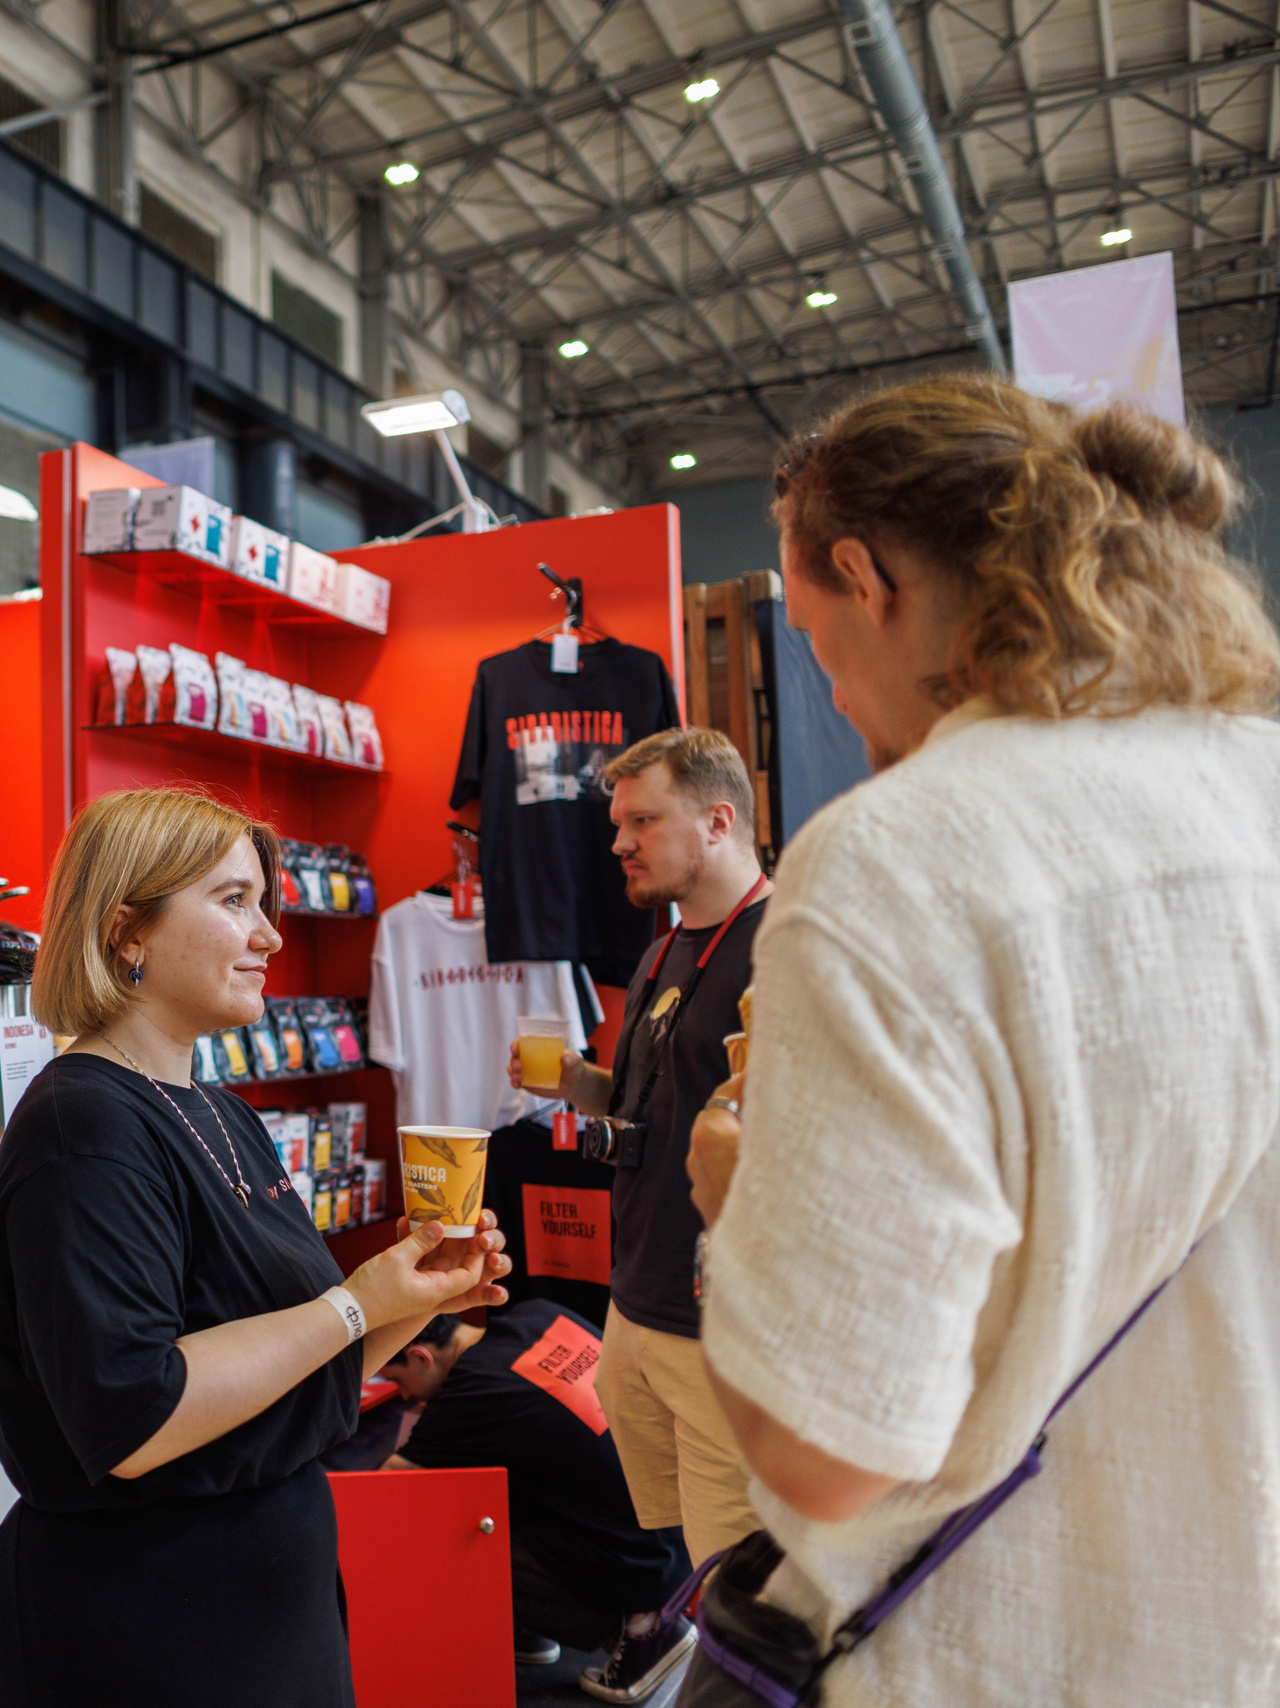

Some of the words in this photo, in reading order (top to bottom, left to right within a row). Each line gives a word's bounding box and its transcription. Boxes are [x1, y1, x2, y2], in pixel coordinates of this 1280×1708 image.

[540, 1201, 578, 1219] FILTER
[541, 1219, 597, 1240] YOURSELF
[538, 1344, 574, 1374] FILTER
[556, 1344, 600, 1386] YOURSELF
